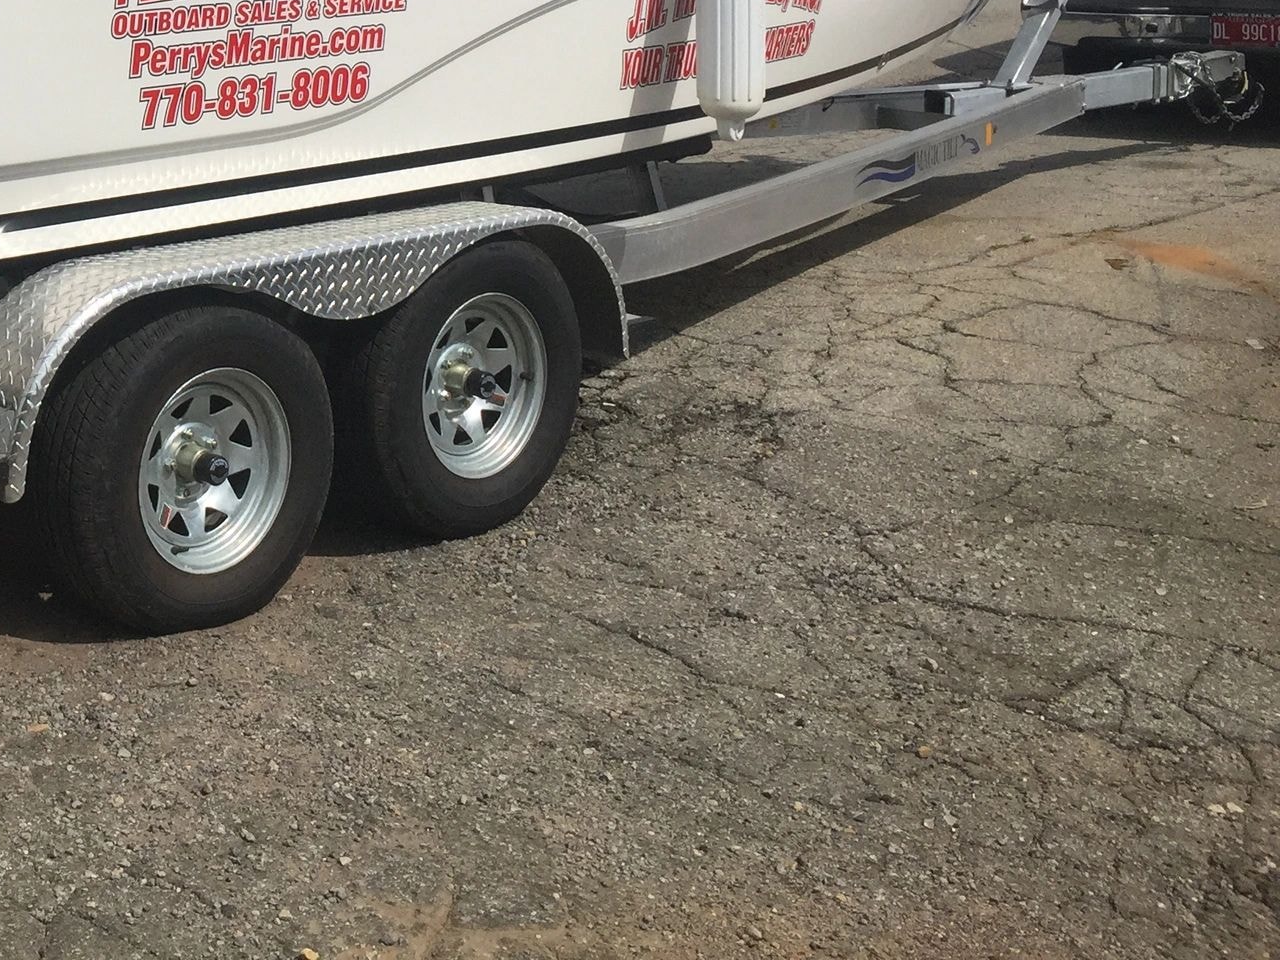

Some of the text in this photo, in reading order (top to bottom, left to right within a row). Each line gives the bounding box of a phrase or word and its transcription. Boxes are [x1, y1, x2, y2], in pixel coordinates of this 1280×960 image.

[112, 3, 233, 38] OUTBOARD
[1213, 22, 1230, 39] DL
[129, 24, 385, 79] PerrysMarine.com
[619, 47, 665, 90] YOUR
[663, 40, 697, 83] TRU
[139, 62, 371, 131] 770-831-8006
